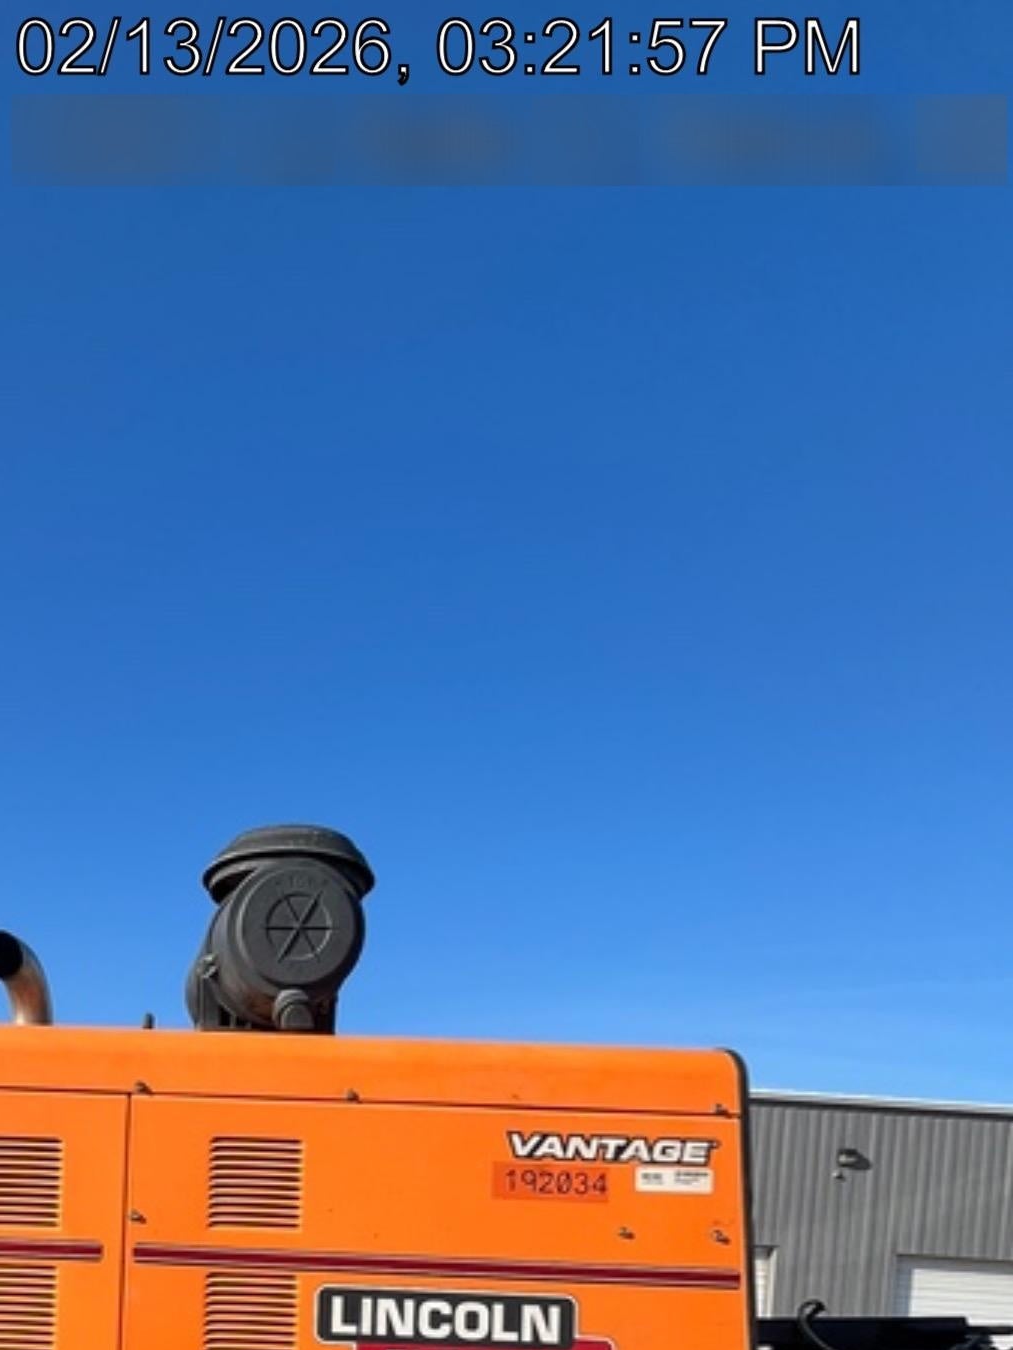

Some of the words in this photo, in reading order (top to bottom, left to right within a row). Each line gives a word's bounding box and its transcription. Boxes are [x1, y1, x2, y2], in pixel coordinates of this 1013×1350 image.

[507, 1131, 714, 1166] VANTAGE
[504, 1168, 608, 1195] 192034
[330, 1294, 562, 1345] LINCOLN
